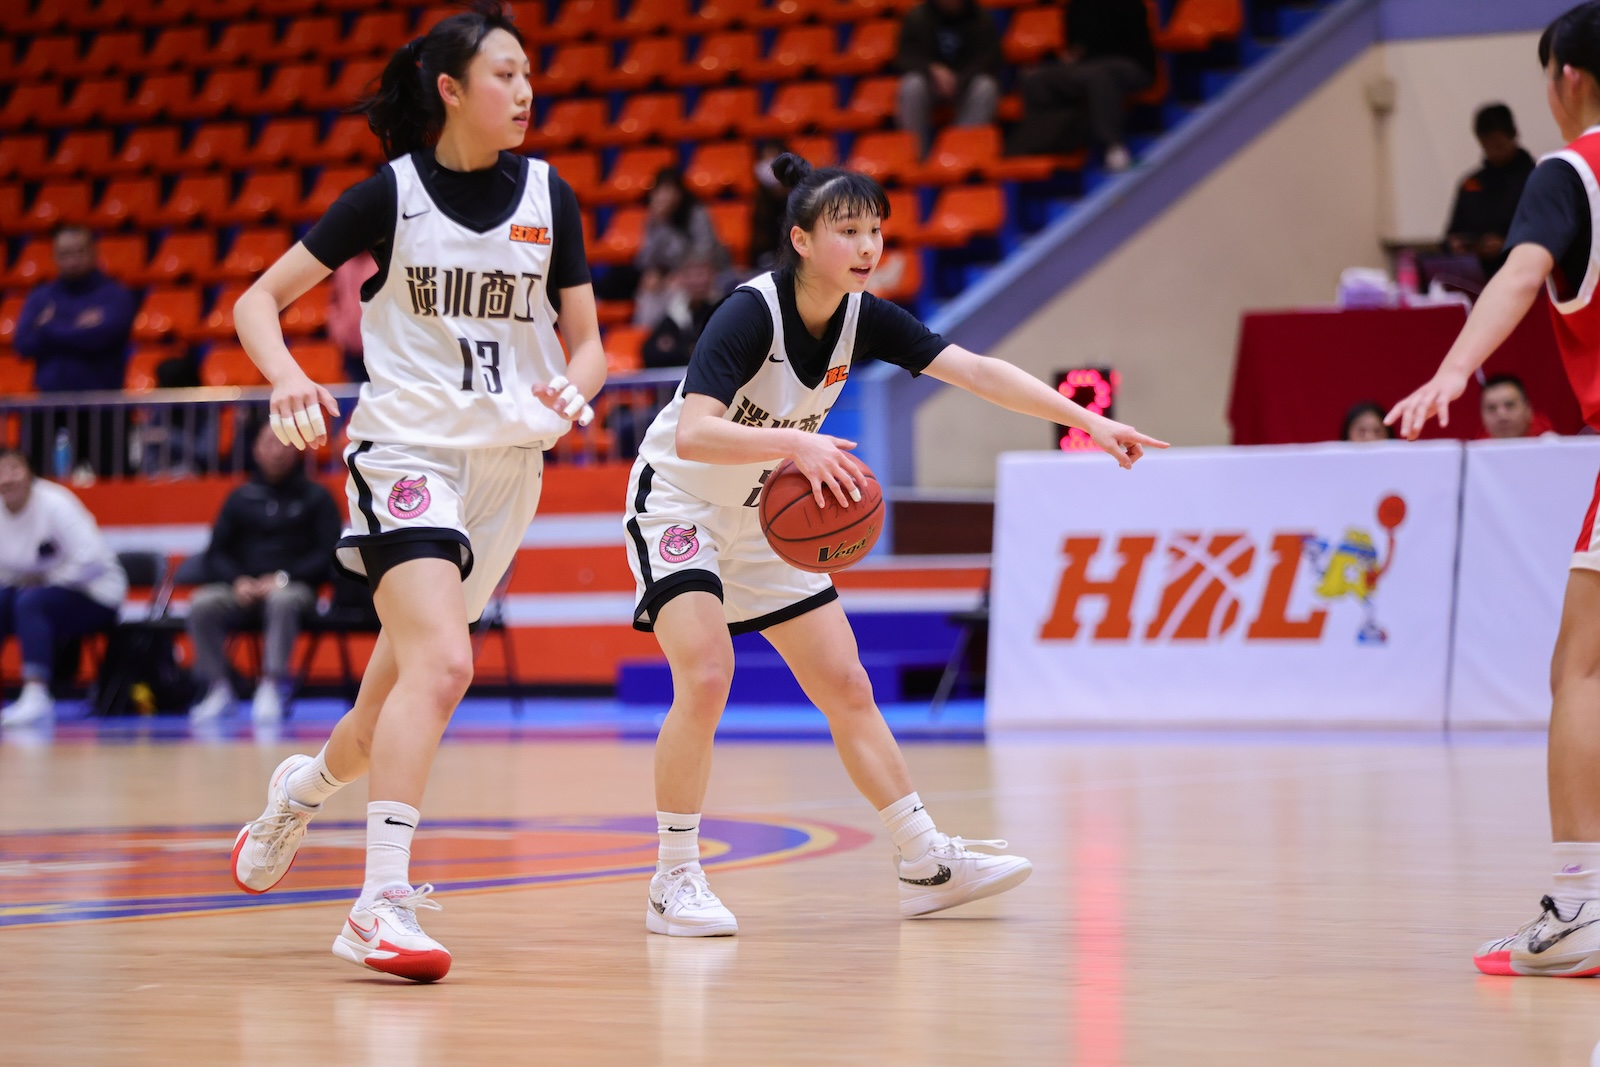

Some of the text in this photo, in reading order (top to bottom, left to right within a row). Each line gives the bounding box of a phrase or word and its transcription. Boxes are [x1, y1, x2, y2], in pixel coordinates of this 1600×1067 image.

[509, 224, 551, 245] HBL
[404, 266, 542, 323] 淡水商工
[457, 337, 503, 394] 13
[817, 540, 867, 562] Vega
[1039, 532, 1328, 642] HBL
